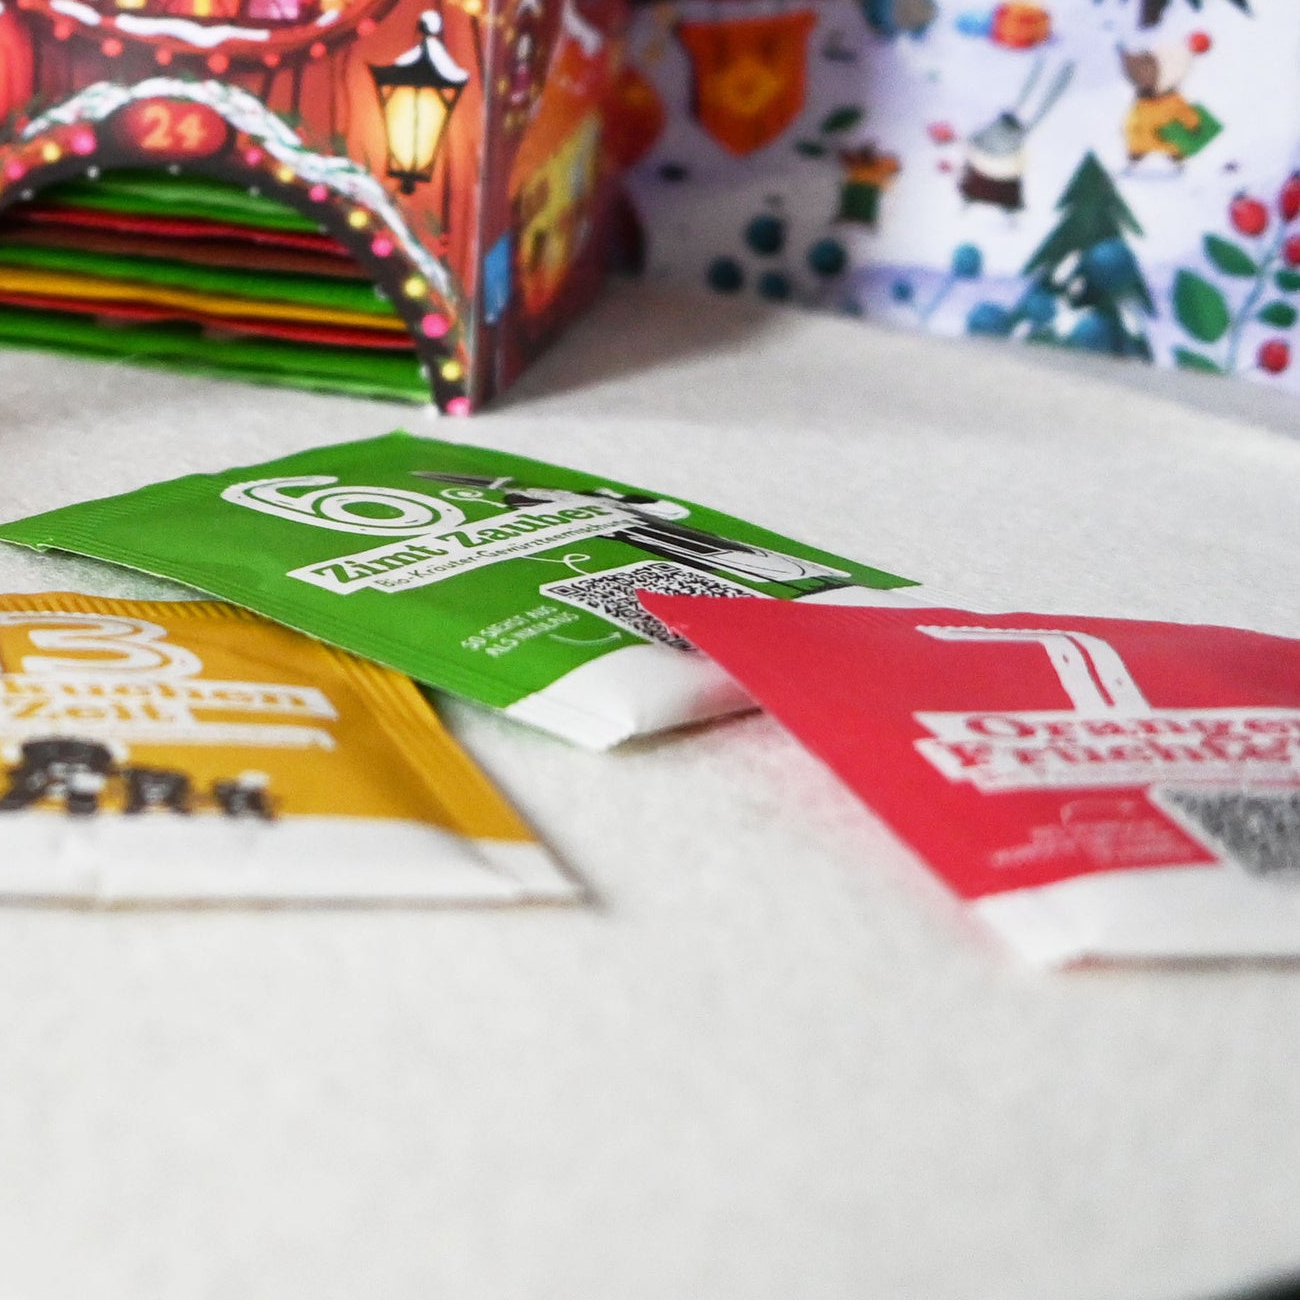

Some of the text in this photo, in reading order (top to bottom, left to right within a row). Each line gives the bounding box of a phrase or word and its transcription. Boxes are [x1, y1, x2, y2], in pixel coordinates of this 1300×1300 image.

[141, 105, 206, 149] 24
[220, 476, 467, 537] 6
[311, 503, 612, 584] Zimt Zauber
[0, 697, 177, 722] Zeit
